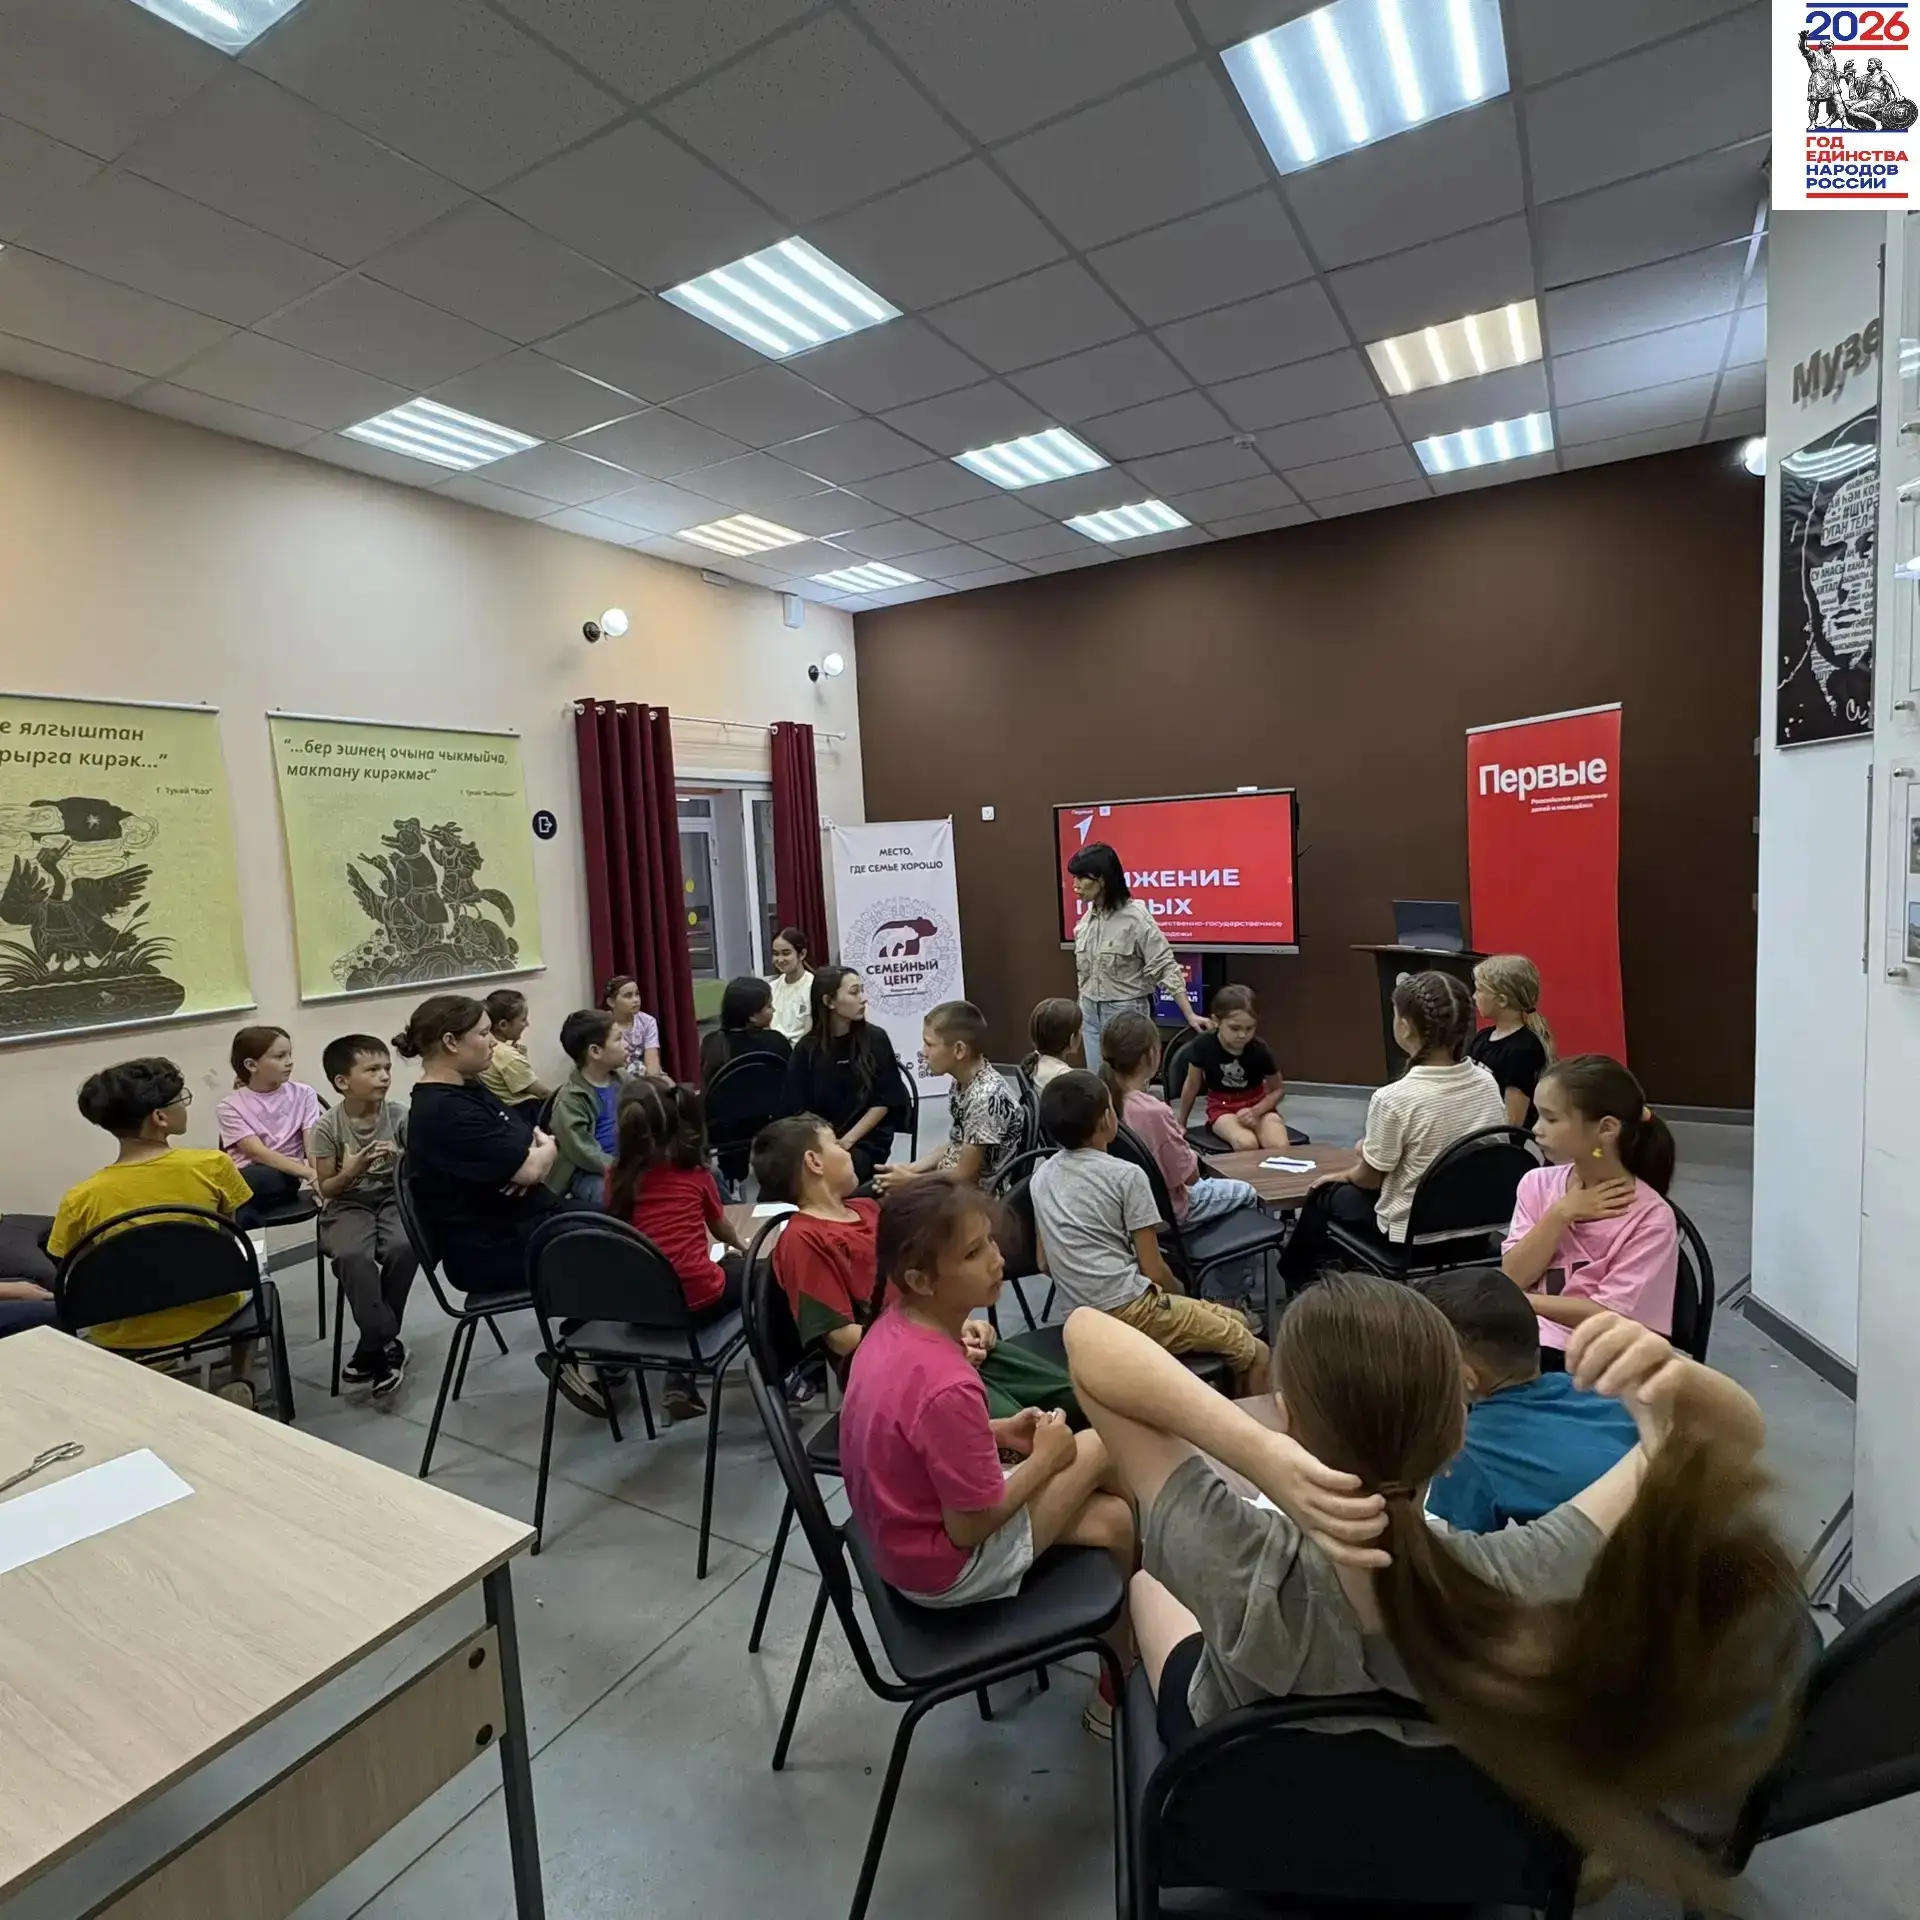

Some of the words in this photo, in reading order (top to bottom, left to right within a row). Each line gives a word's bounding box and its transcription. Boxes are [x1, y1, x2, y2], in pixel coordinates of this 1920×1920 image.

[19, 722, 144, 741] ялгыштан
[336, 745, 386, 760] эшнең
[390, 747, 434, 760] очына
[438, 750, 508, 766] чыкмыйча,
[287, 764, 360, 781] мактану
[1479, 758, 1608, 801] Первые
[850, 864, 866, 874] ГДЕ
[868, 863, 899, 873] СЕМЬЕ
[900, 860, 943, 871] ХОРОШО
[866, 959, 939, 975] СЕМЕЙНЫЙ
[884, 974, 924, 986] ЦЕНТР
